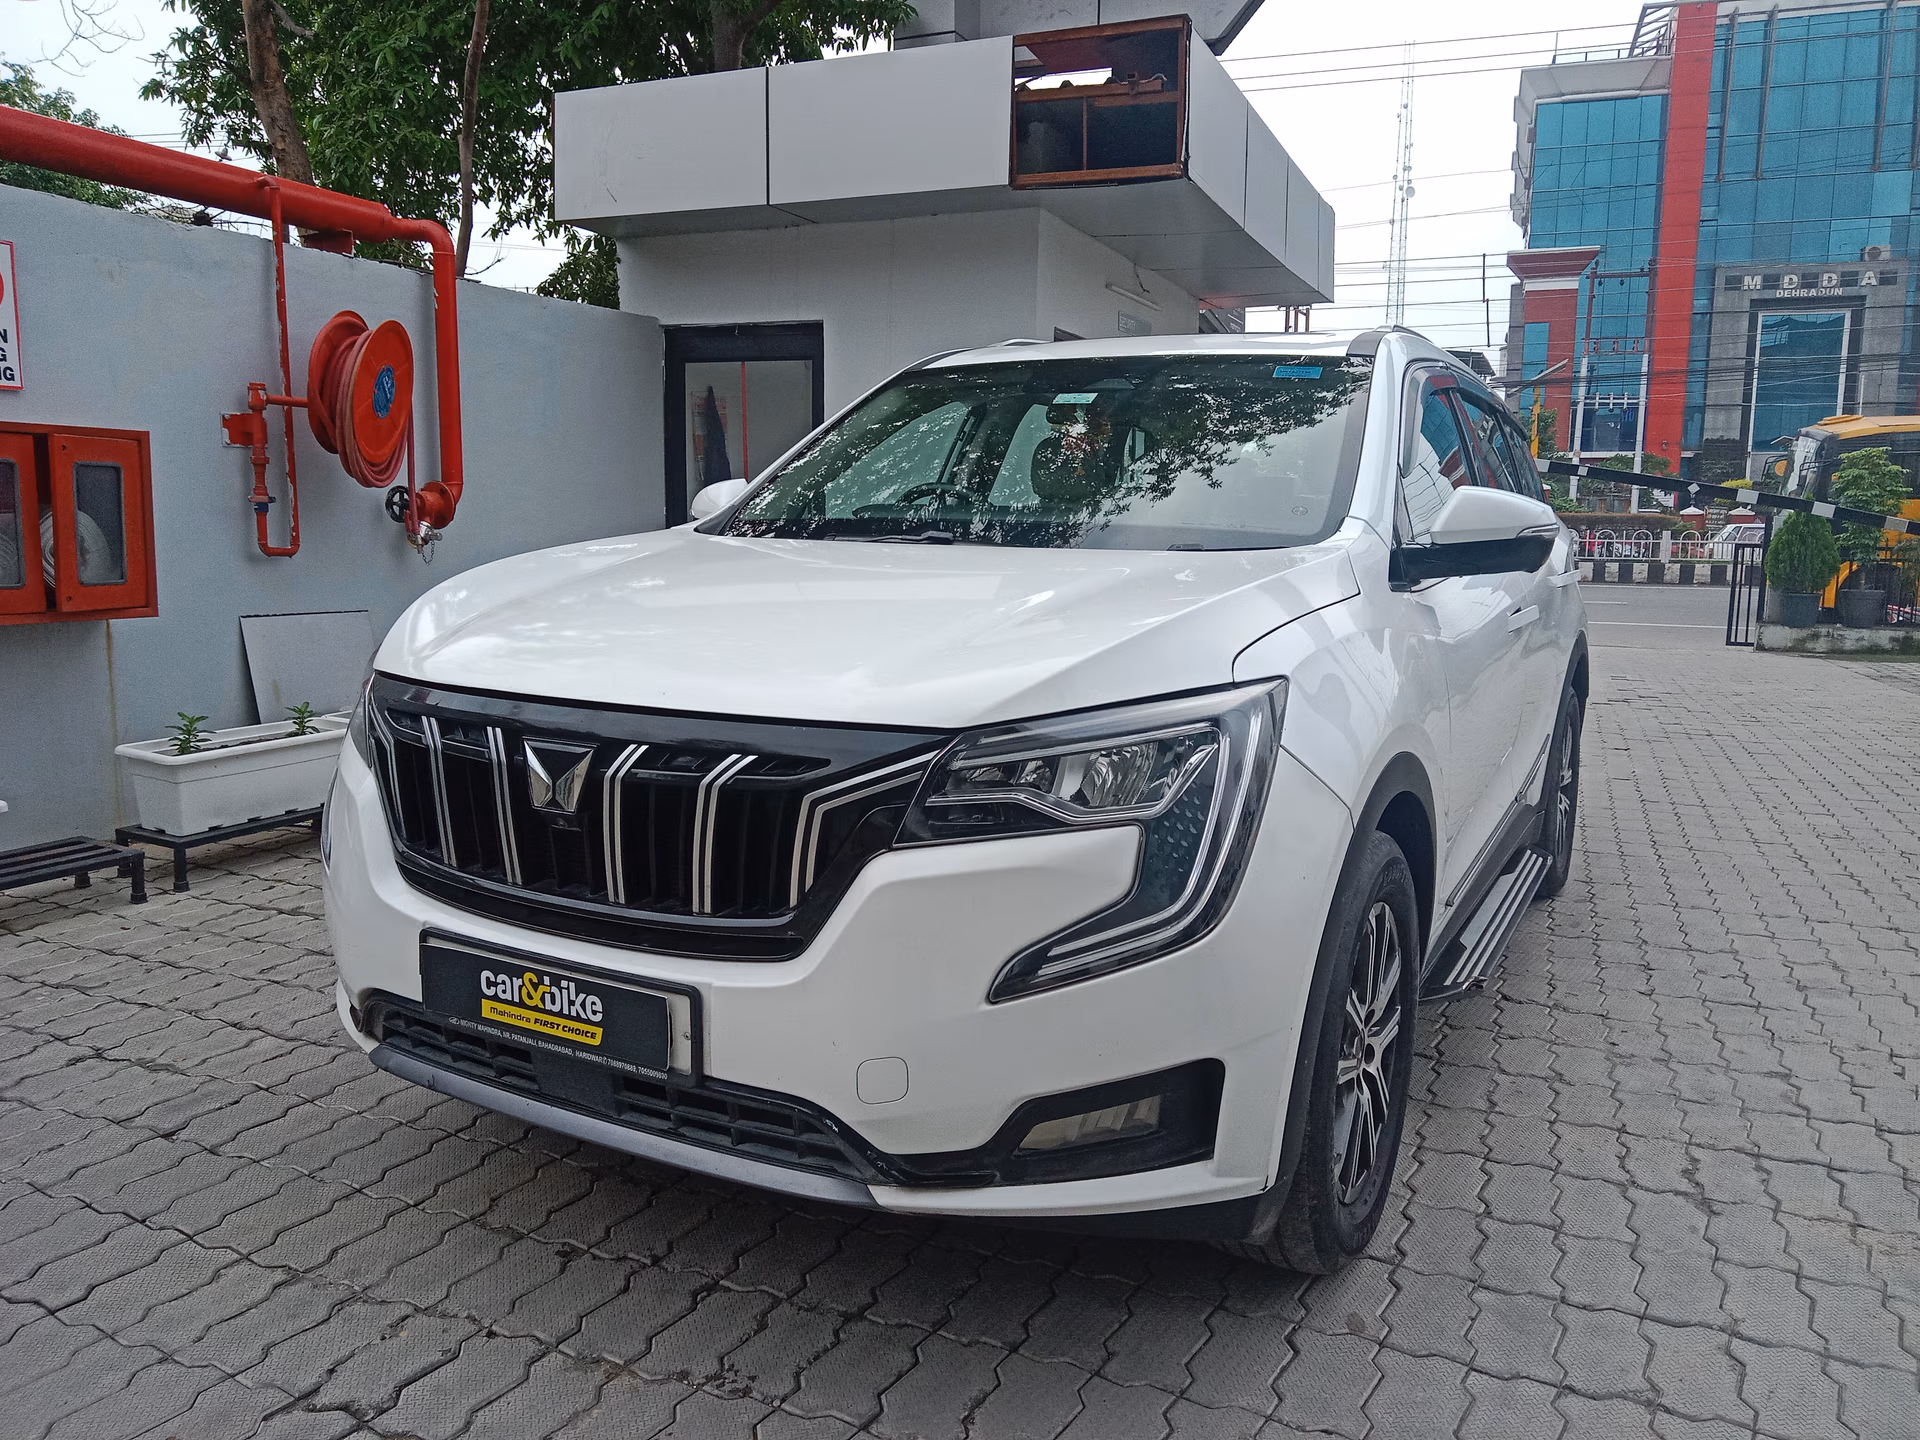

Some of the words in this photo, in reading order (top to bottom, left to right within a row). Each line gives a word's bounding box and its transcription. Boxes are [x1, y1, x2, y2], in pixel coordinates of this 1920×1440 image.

[1776, 287, 1843, 298] DEHRADUN
[480, 970, 603, 1023] car&bike
[533, 1017, 561, 1031] FIRST
[562, 1024, 597, 1040] CHOICE
[575, 1050, 602, 1063] HARIDWAR
